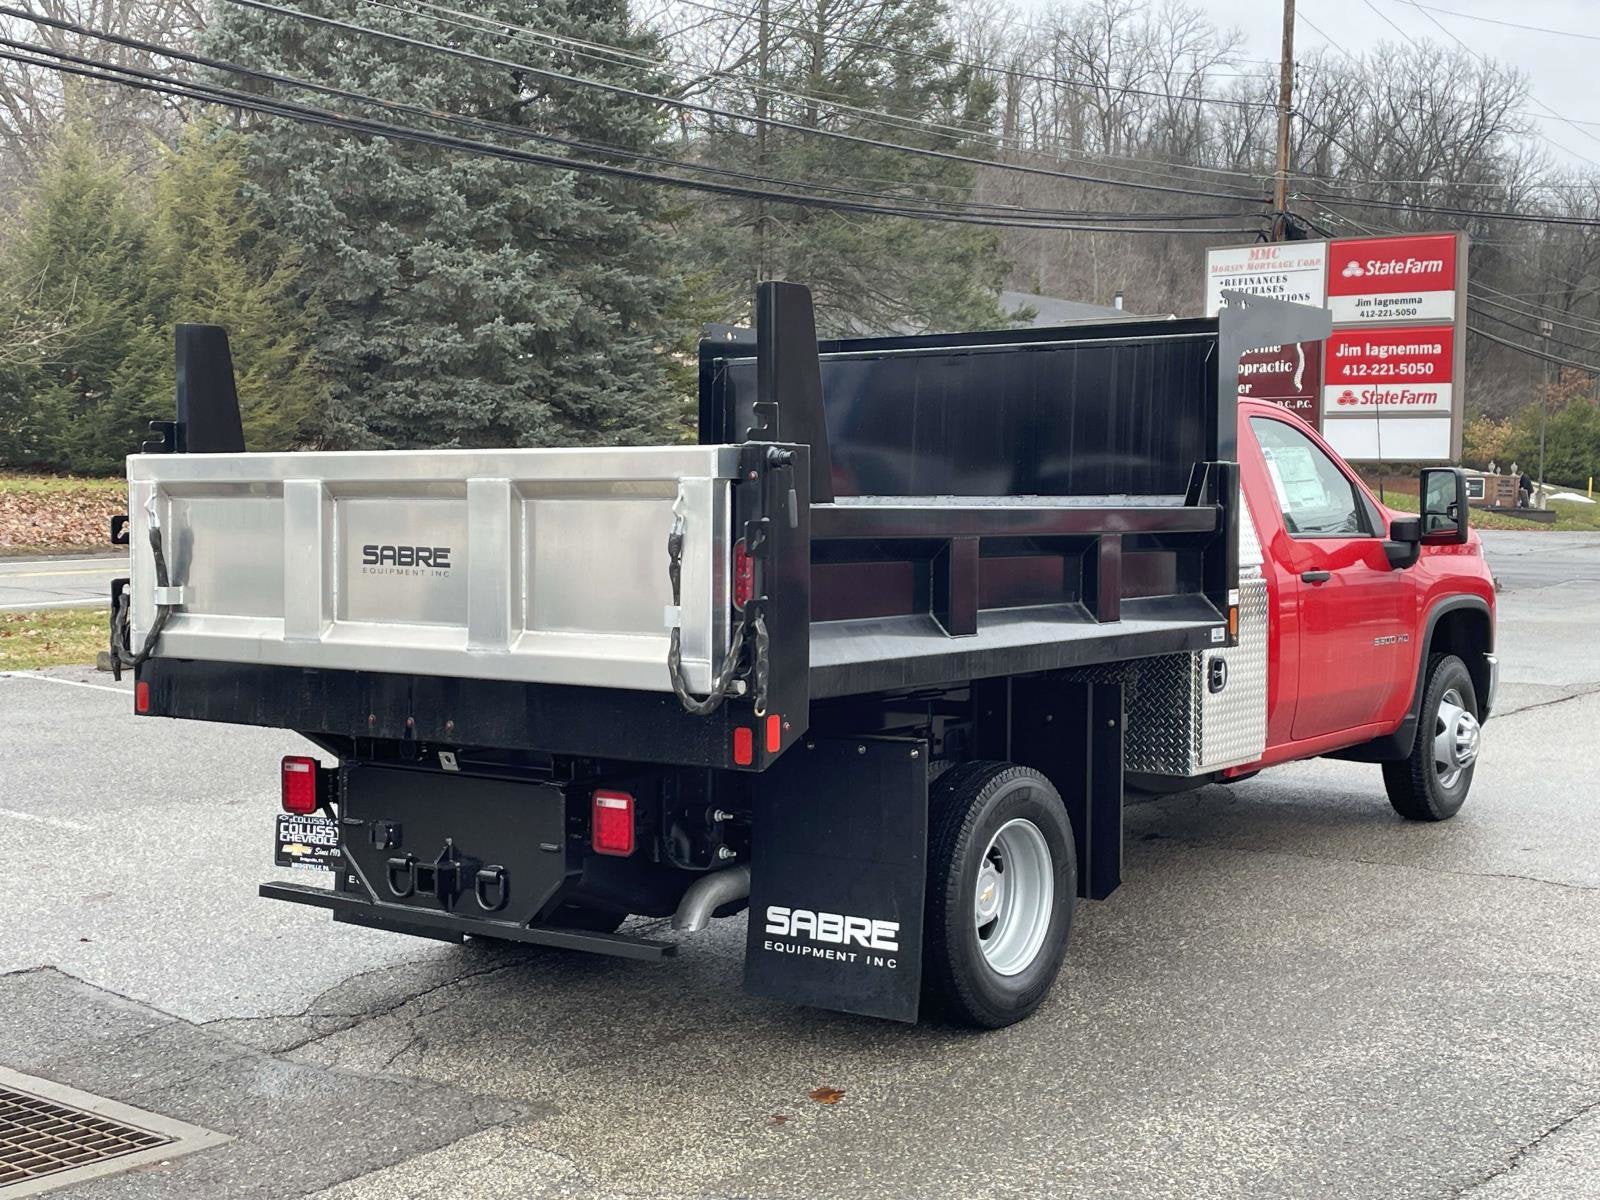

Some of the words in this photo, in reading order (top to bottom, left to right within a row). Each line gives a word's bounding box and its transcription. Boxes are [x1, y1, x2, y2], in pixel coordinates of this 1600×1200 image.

[1248, 247, 1281, 261] MMC
[1247, 260, 1294, 270] MORTGAGE
[1355, 298, 1371, 307] Jim
[1374, 297, 1423, 307] Iagnemma
[1360, 308, 1417, 318] 412-221-5050
[1336, 343, 1361, 357] Jim
[1365, 342, 1442, 359] Iagnemma
[1342, 363, 1434, 376] 412-221-5050
[363, 545, 451, 568] SABRE
[362, 567, 425, 576] EQUIPMENT
[280, 833, 338, 846] CHEVROLE
[765, 906, 900, 951] SABRE
[764, 940, 857, 963] EQUIPMENT
[866, 956, 897, 969] INC
